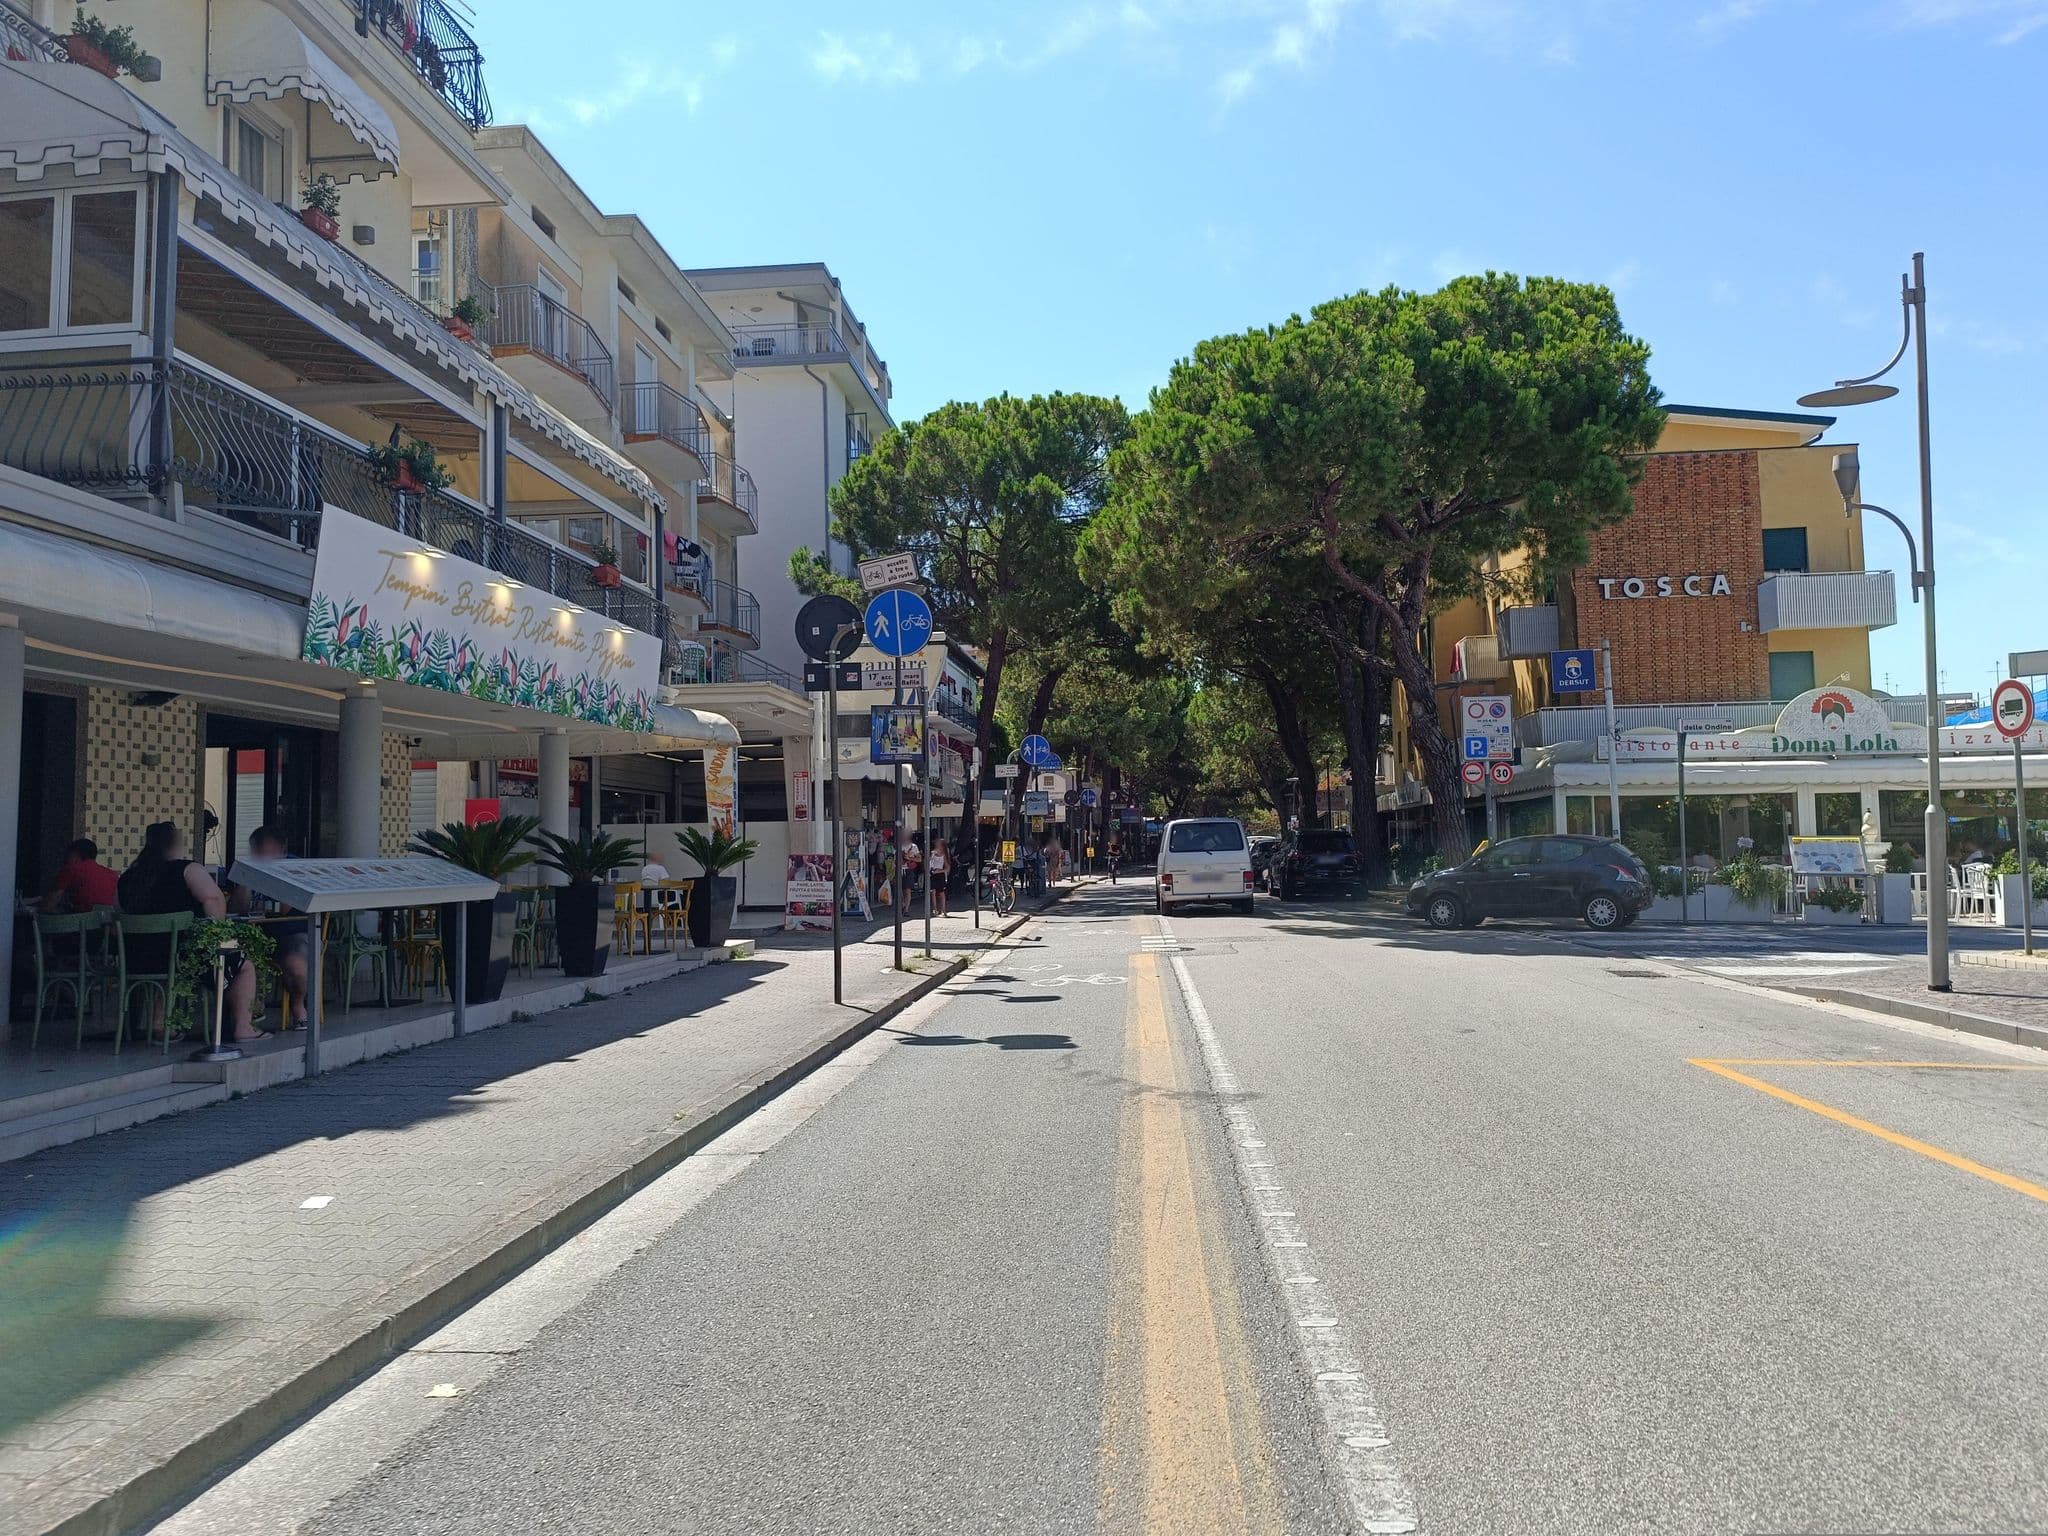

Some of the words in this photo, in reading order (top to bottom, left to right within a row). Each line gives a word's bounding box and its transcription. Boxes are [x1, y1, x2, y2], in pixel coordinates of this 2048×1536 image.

[1598, 574, 1732, 600] TOSCA
[451, 580, 517, 628] Bistrot
[512, 605, 588, 653] Ristorante
[586, 631, 636, 680] Pizzeria
[1559, 678, 1590, 687] DERSUT
[1615, 738, 1741, 752] ristoante
[1772, 735, 1837, 753] Dona
[1844, 733, 1898, 752] Lola
[1495, 768, 1509, 778] 30
